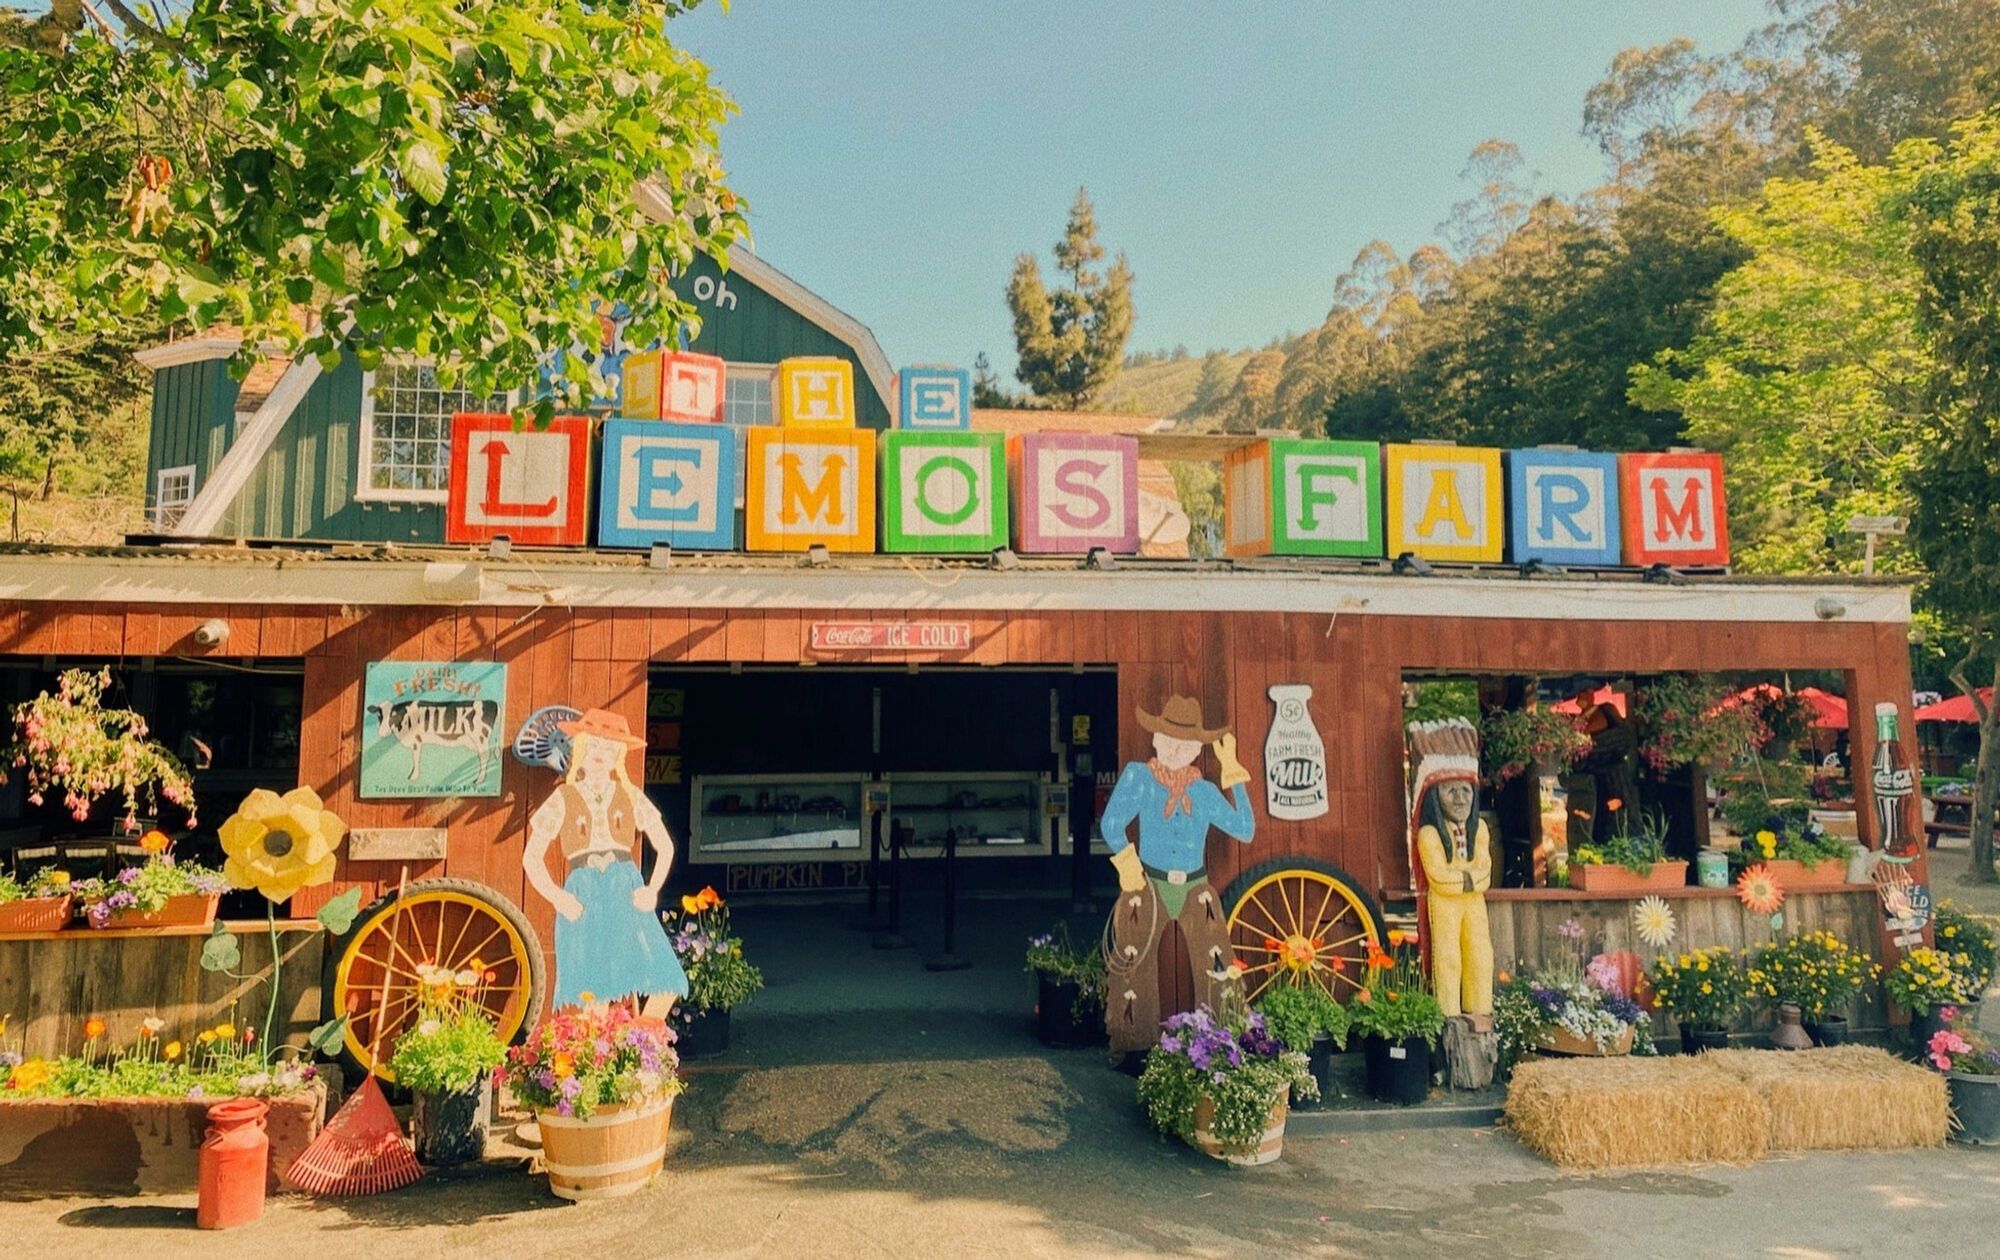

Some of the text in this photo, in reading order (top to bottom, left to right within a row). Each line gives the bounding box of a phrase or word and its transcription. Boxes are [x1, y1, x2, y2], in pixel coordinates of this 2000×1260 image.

[478, 440, 1708, 542] LEMOS FARM
[888, 625, 911, 646] ICE
[920, 625, 959, 646] COLD
[401, 705, 476, 737] MILK
[1284, 703, 1301, 718] 5¢
[1268, 744, 1322, 760] FARM FRESH
[1271, 761, 1323, 788] Milk
[730, 862, 824, 891] PUMPKIN
